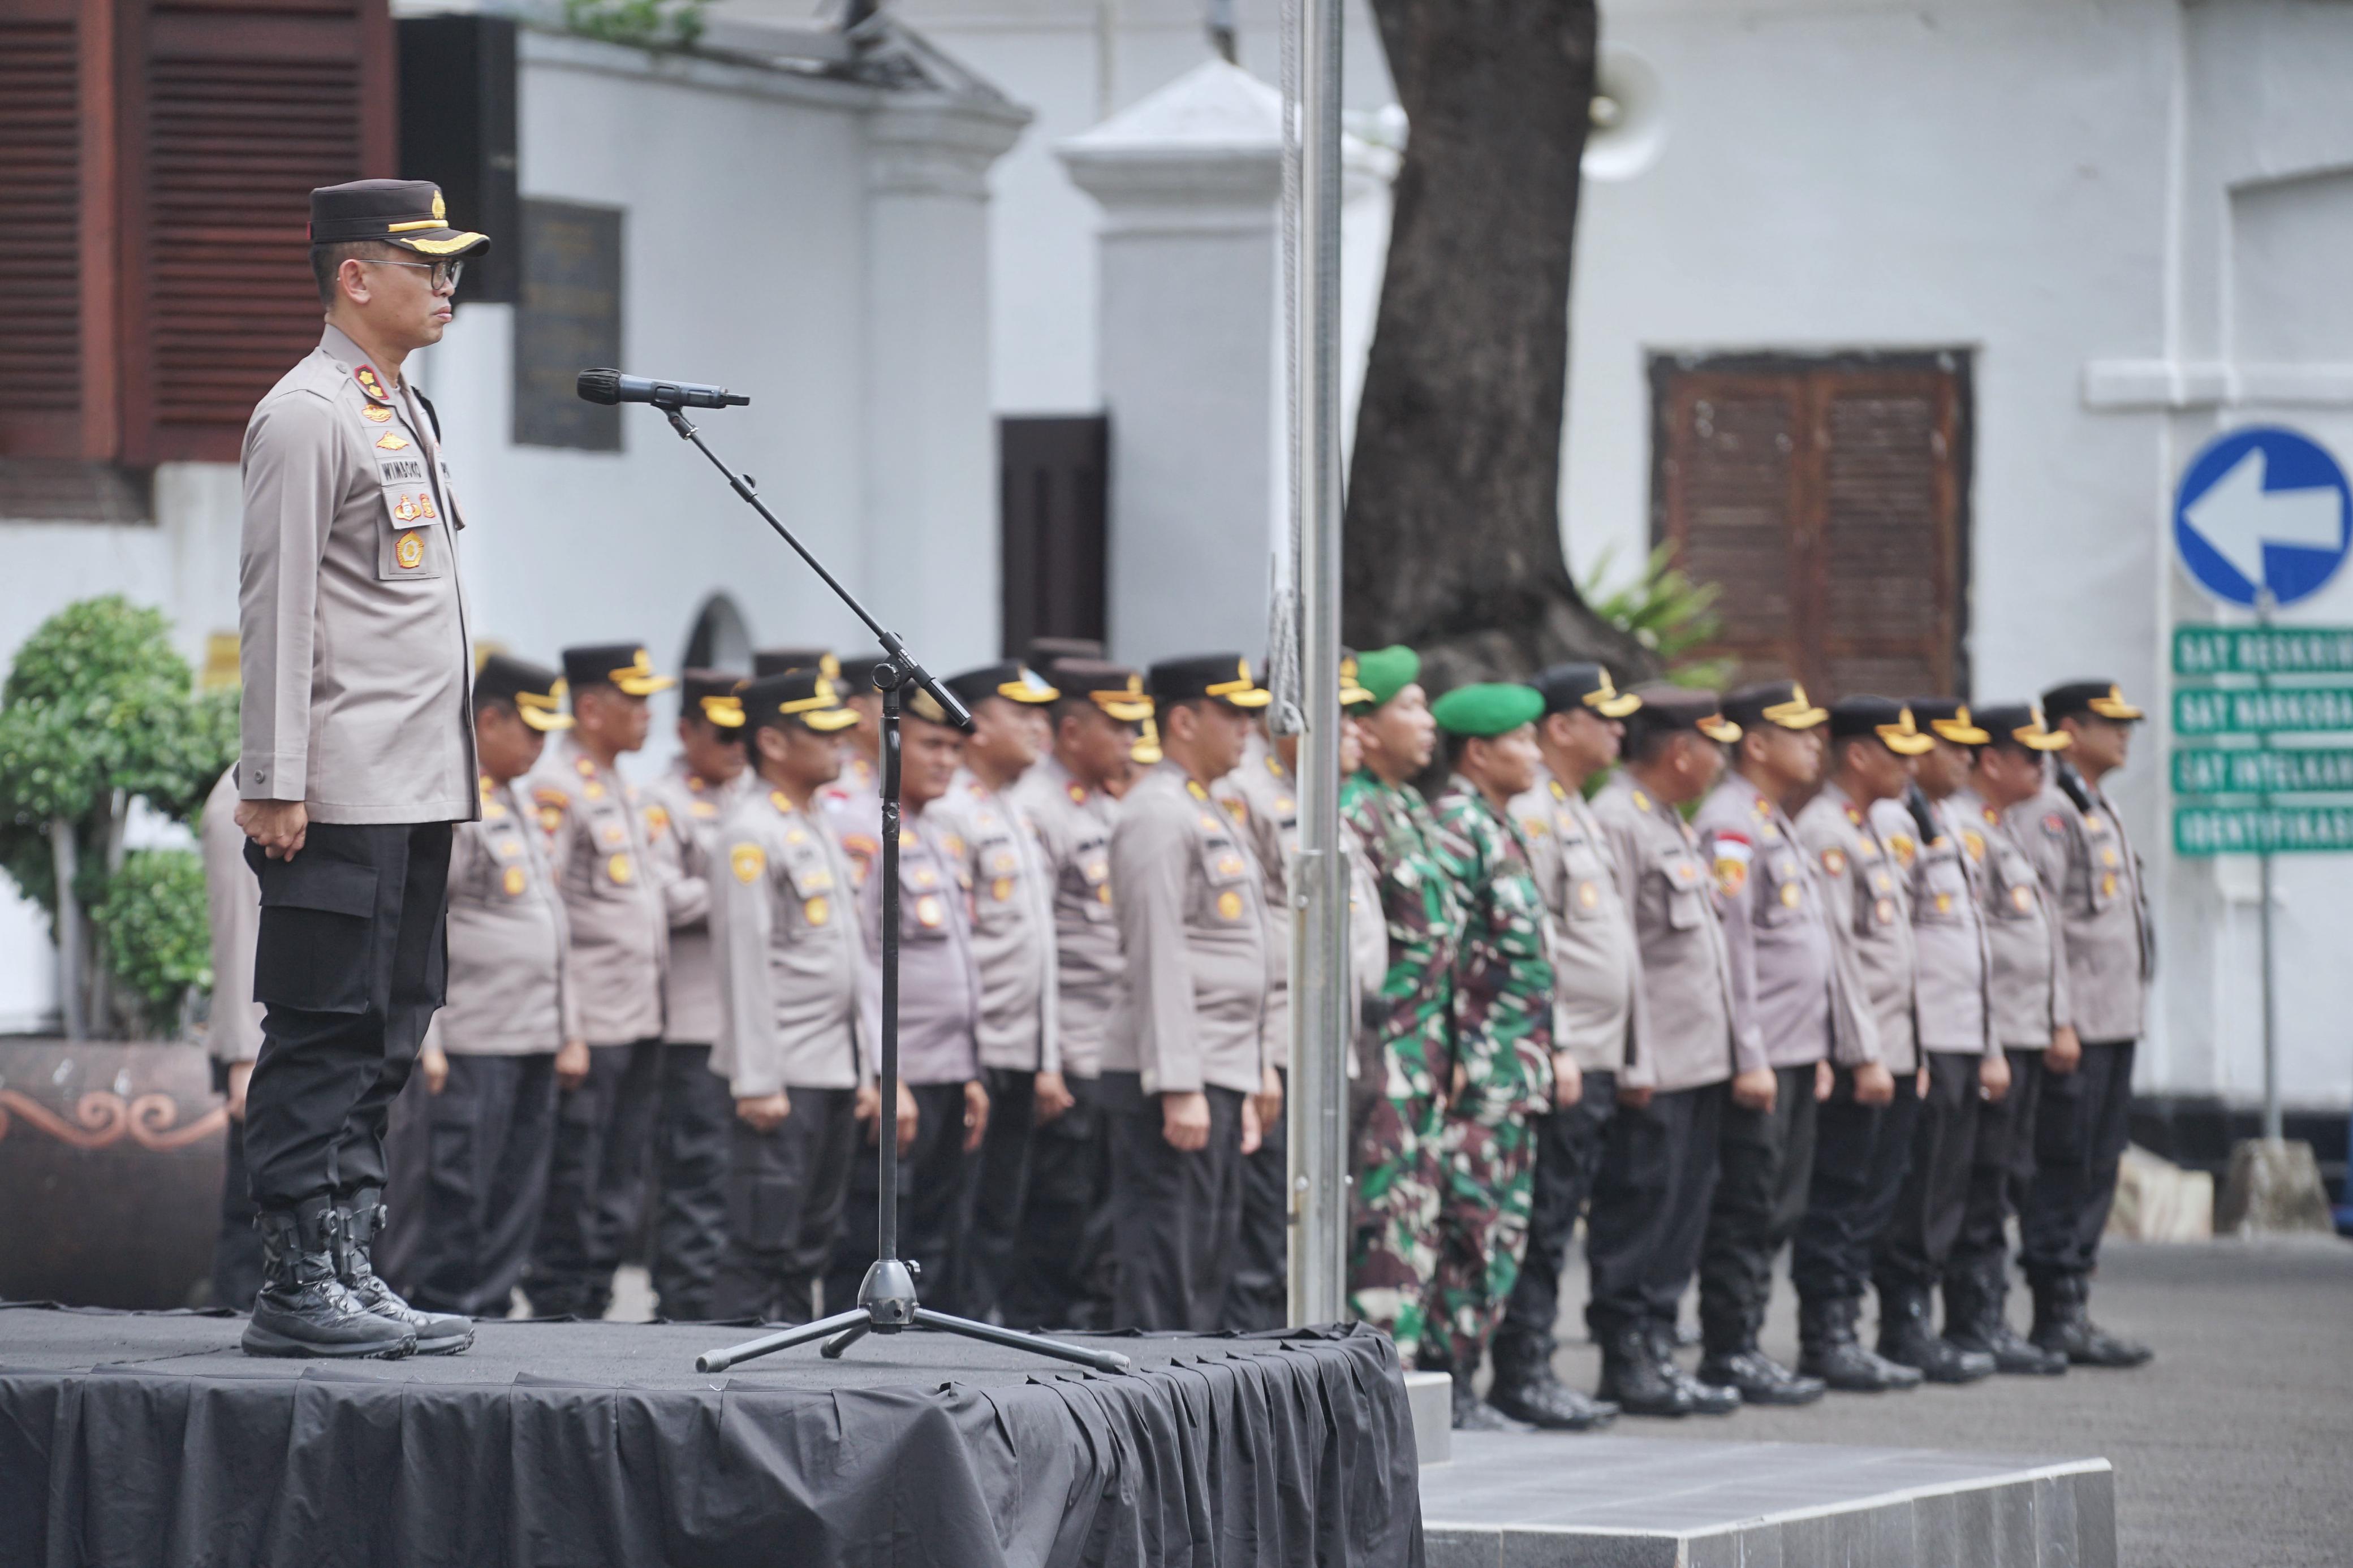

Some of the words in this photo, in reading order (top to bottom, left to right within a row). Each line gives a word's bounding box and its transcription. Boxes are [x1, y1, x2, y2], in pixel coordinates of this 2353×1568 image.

[2179, 634, 2229, 669] SAT
[2179, 695, 2227, 728] SAT
[2179, 755, 2226, 787] SAT
